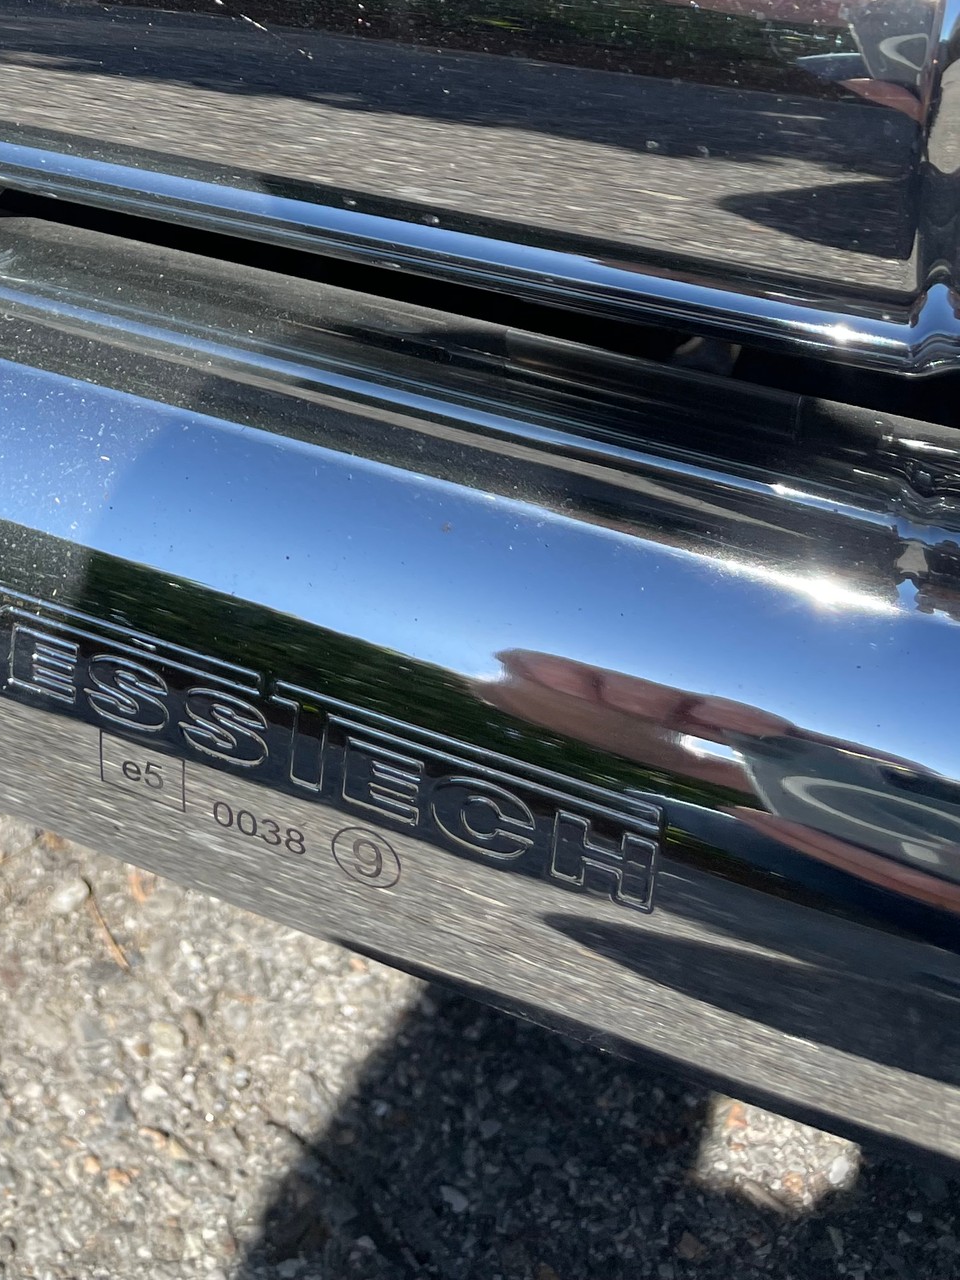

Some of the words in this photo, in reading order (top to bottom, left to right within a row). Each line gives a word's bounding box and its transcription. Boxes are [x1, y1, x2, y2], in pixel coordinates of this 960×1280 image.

[122, 759, 165, 790] e5
[213, 801, 307, 856] 0038
[353, 839, 384, 879] 9
